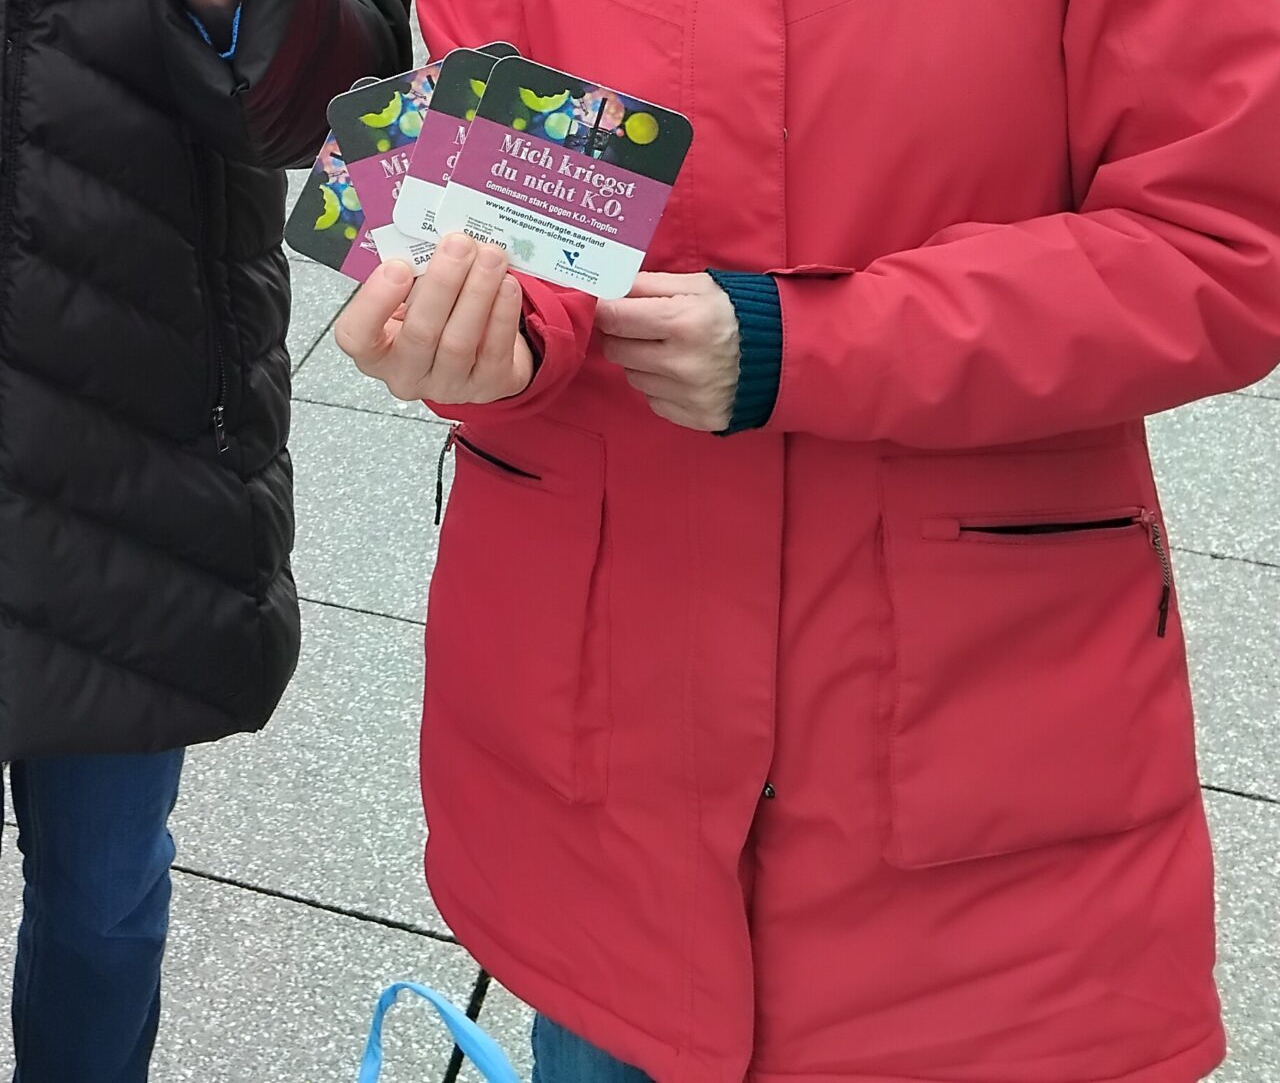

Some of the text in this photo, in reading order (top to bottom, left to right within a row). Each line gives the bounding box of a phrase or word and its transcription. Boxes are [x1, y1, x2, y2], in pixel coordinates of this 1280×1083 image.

[491, 159, 625, 221] du nicht K.O.
[498, 133, 554, 170] Mich
[557, 154, 636, 198] kriegst
[485, 199, 605, 248] www.frauenbeauftragte.saarland
[486, 180, 528, 202] Gemeinsam
[528, 196, 548, 210] stark
[549, 203, 572, 218] gegen
[499, 213, 586, 250] www.spuren-sichern.de
